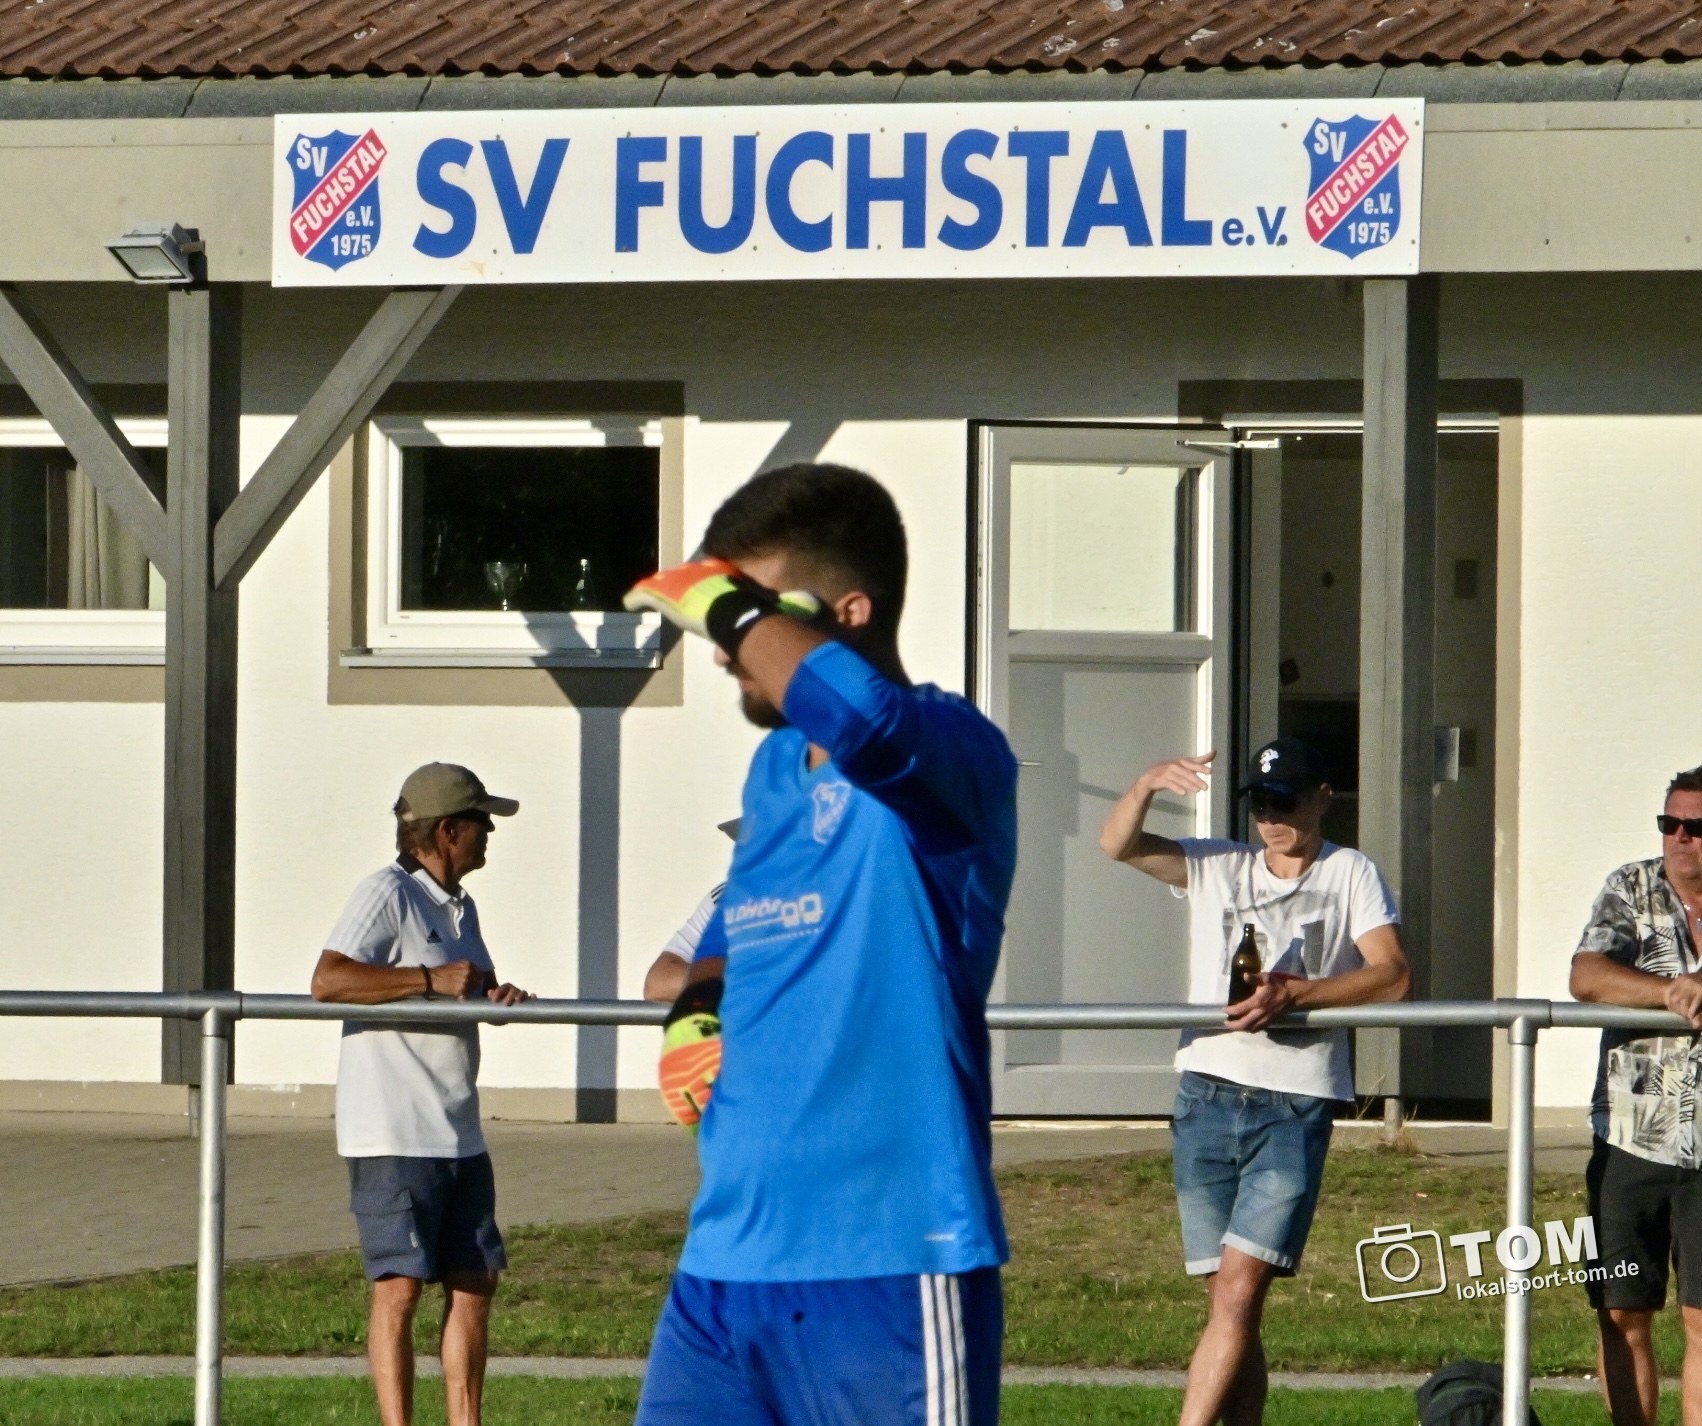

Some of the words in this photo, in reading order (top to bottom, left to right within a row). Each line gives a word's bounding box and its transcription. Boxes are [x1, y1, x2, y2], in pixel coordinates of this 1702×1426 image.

[296, 137, 328, 177] SV
[1313, 122, 1347, 163] SV
[292, 138, 386, 243] FUCHSTAL
[412, 137, 571, 258] SV
[614, 128, 1213, 254] FUCHSTAL
[1221, 206, 1288, 246] e.V.
[1308, 123, 1407, 231] FUCHSTAL
[345, 205, 374, 227] e.V.
[1363, 192, 1394, 215] e.V.
[331, 234, 372, 256] 1975
[1347, 221, 1391, 244] 1975
